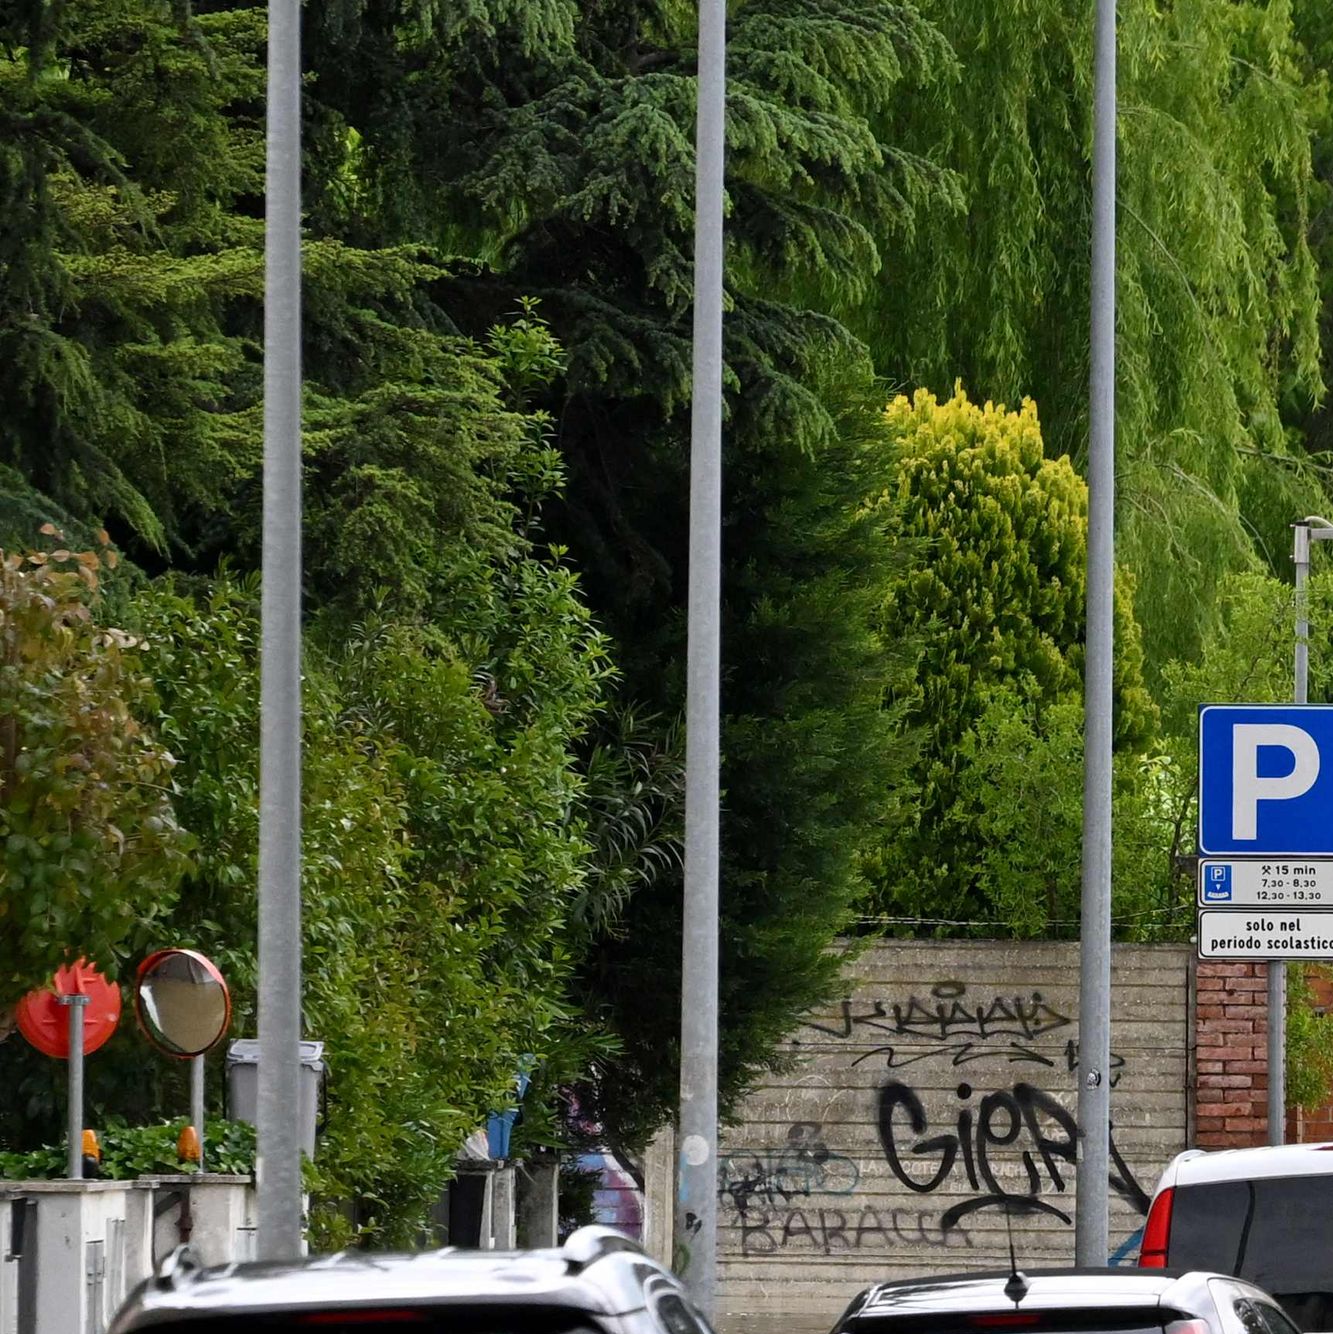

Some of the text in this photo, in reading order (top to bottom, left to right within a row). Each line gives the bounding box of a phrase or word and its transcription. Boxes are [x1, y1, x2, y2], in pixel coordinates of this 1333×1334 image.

[1232, 723, 1320, 840] P
[1275, 865, 1316, 875] 15 min
[1246, 918, 1301, 931] solo nel
[1211, 936, 1262, 951] periodo
